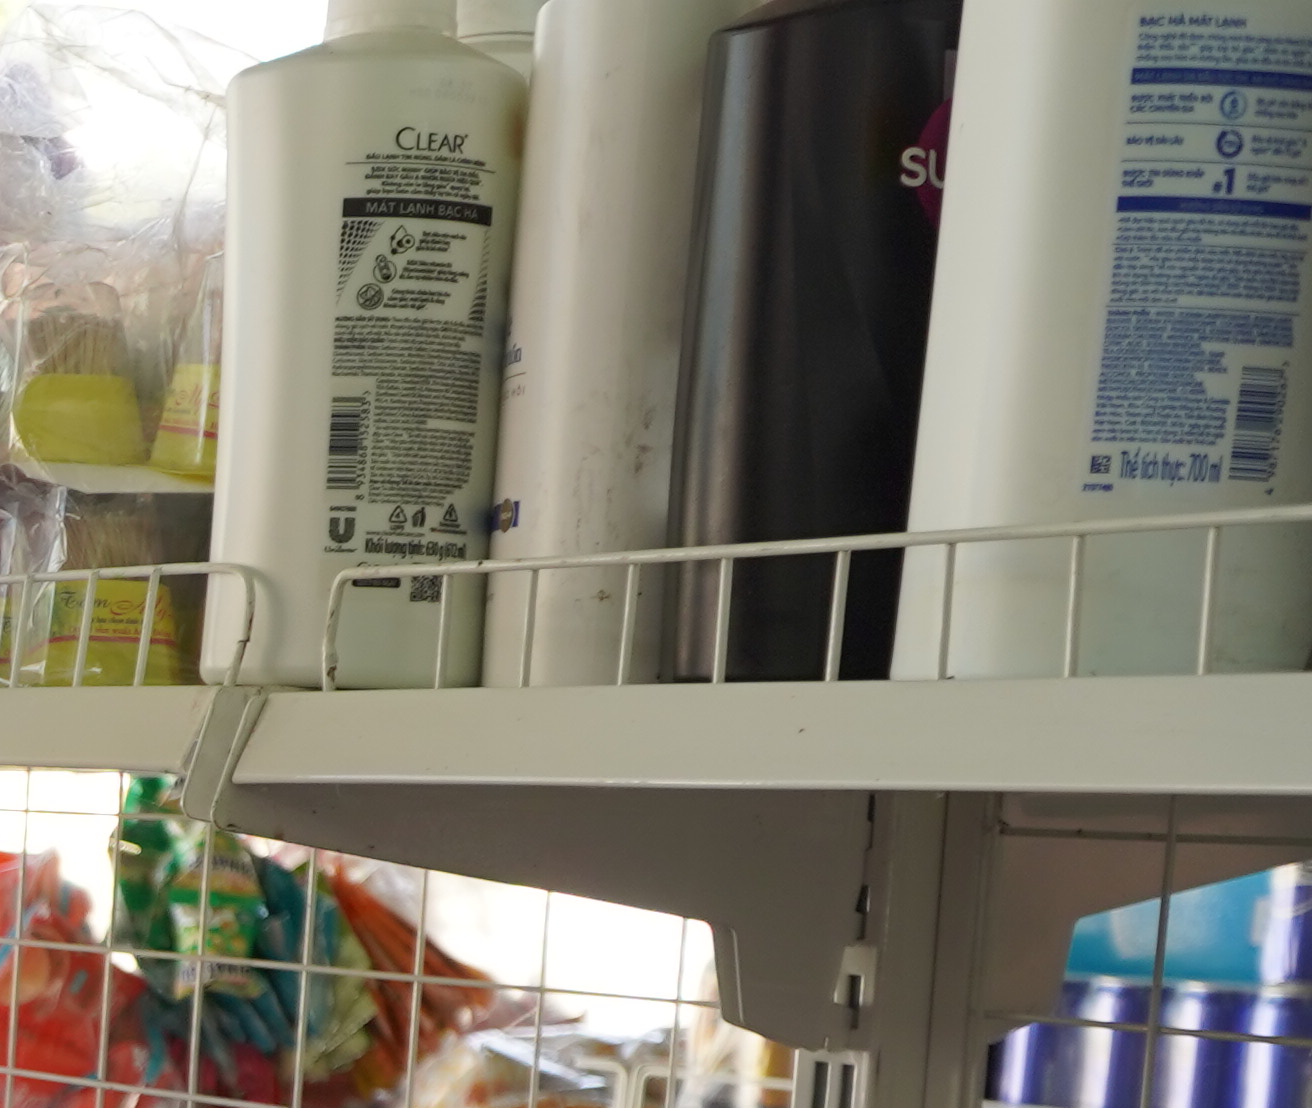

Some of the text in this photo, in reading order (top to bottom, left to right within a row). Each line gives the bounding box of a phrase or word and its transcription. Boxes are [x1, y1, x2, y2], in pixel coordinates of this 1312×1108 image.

[396, 126, 466, 154] CLEAR
[365, 200, 395, 214] MÁT
[399, 202, 435, 217] LẠNH
[438, 204, 463, 219] BẠC
